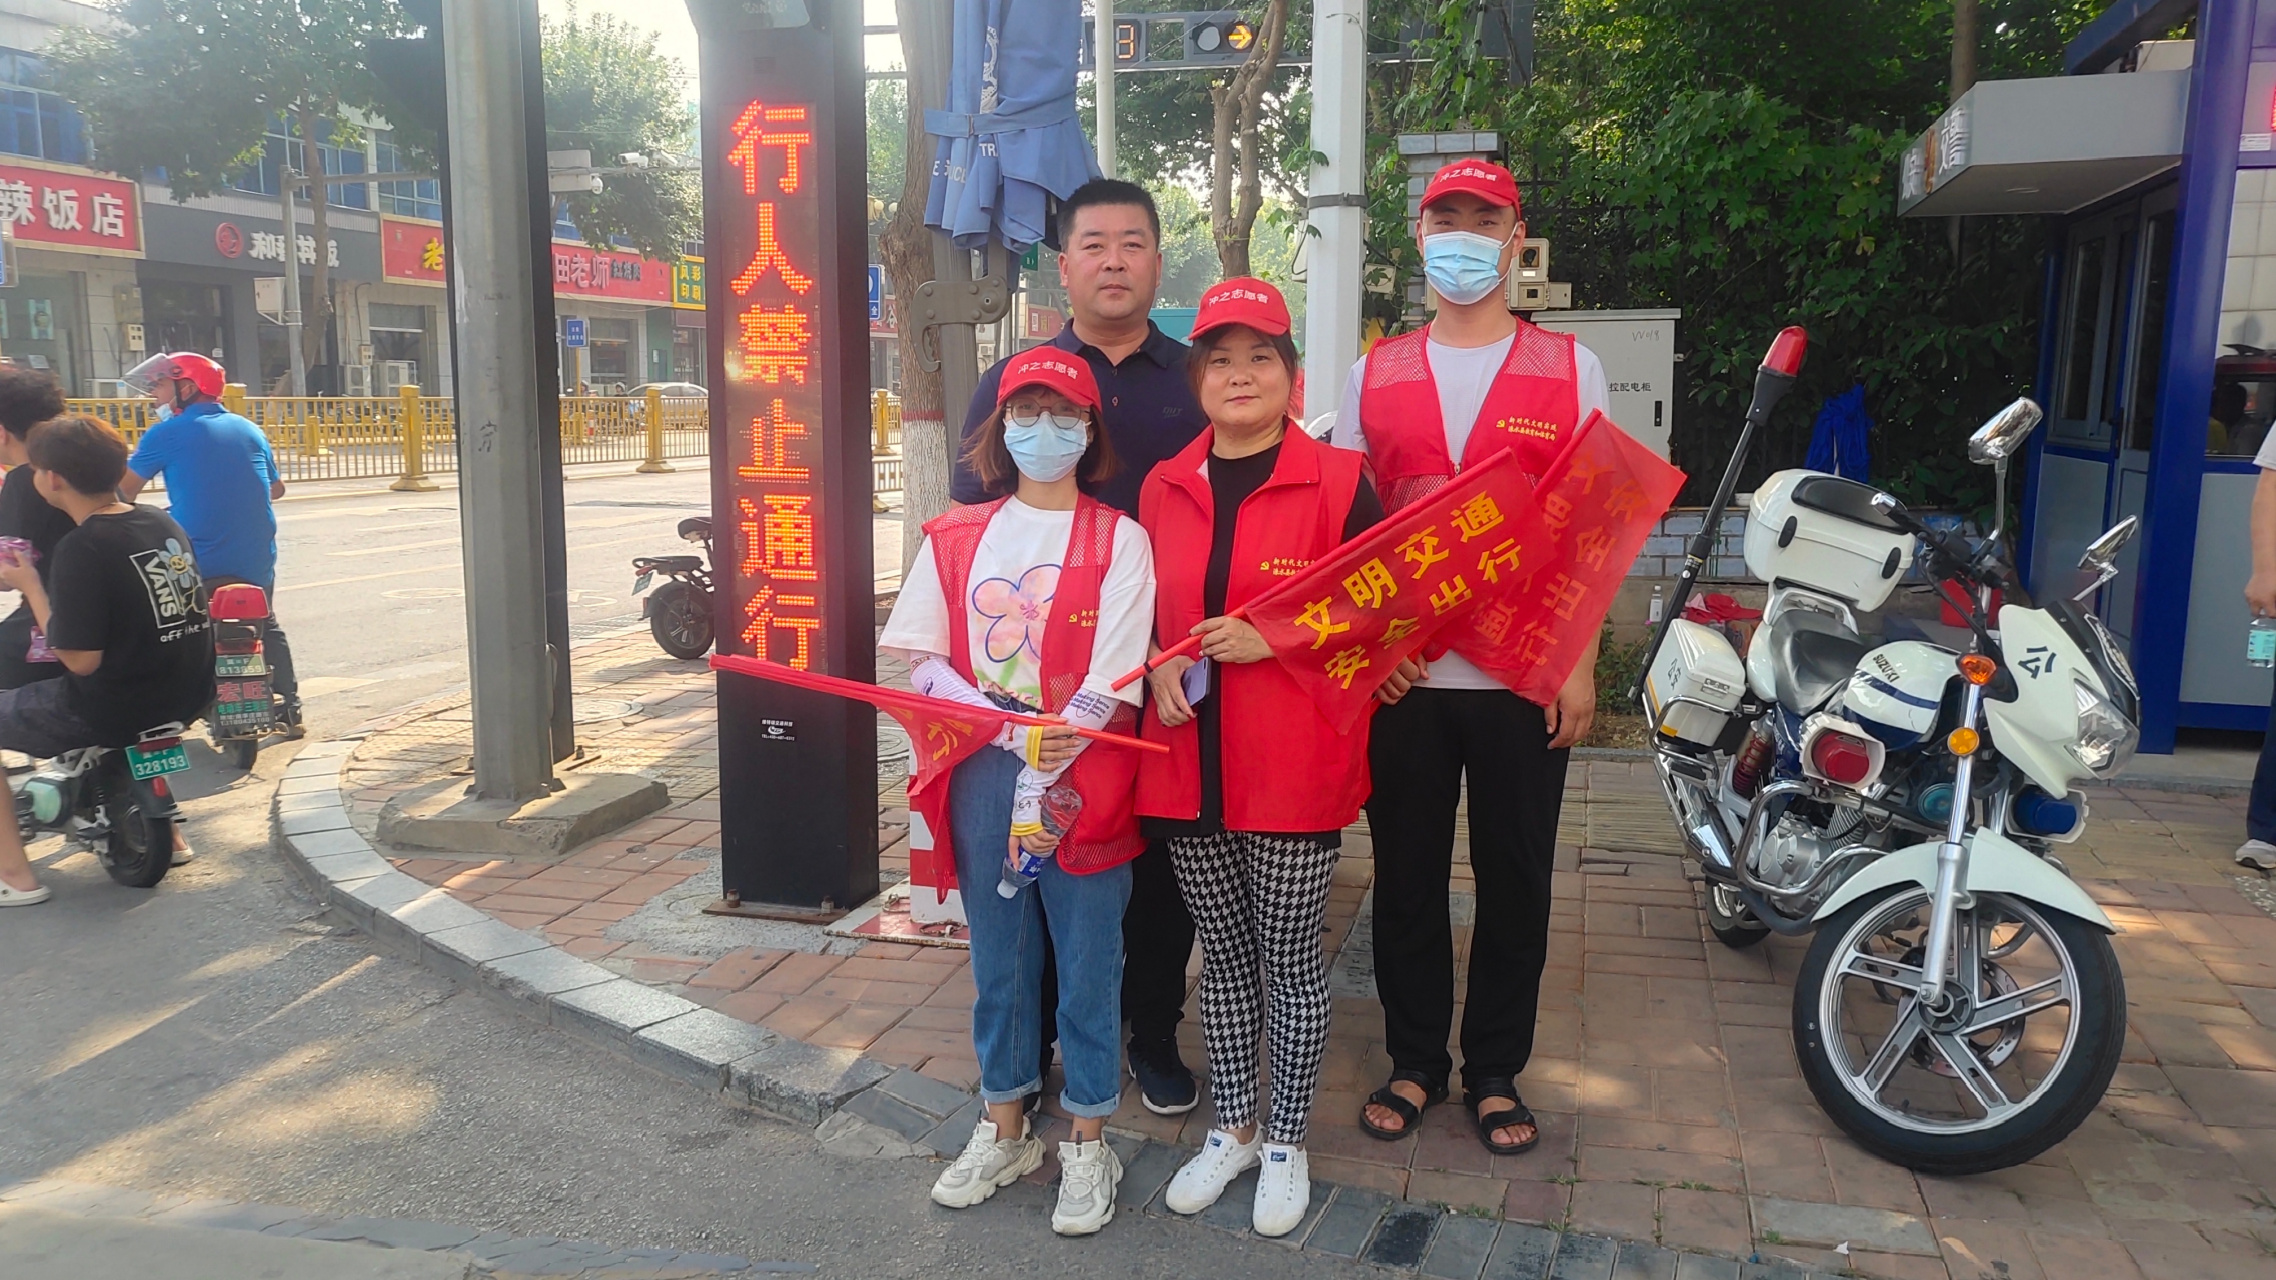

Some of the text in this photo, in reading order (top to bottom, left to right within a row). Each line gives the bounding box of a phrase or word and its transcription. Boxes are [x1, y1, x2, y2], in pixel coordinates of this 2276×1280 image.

[0, 178, 125, 238] 辣饭店
[554, 252, 611, 289] 田老师
[1208, 288, 1269, 308] 冲之志愿者
[726, 100, 820, 671] 行人禁止通行
[1017, 360, 1079, 380] 冲之志愿者
[144, 556, 178, 617] VANS
[1293, 490, 1505, 651] 文明交通
[1324, 537, 1522, 690] 安全出行
[160, 628, 184, 643] off
[1872, 653, 1900, 683] SUZUKI
[217, 681, 268, 702] 宏旺
[135, 755, 186, 776] 328193
